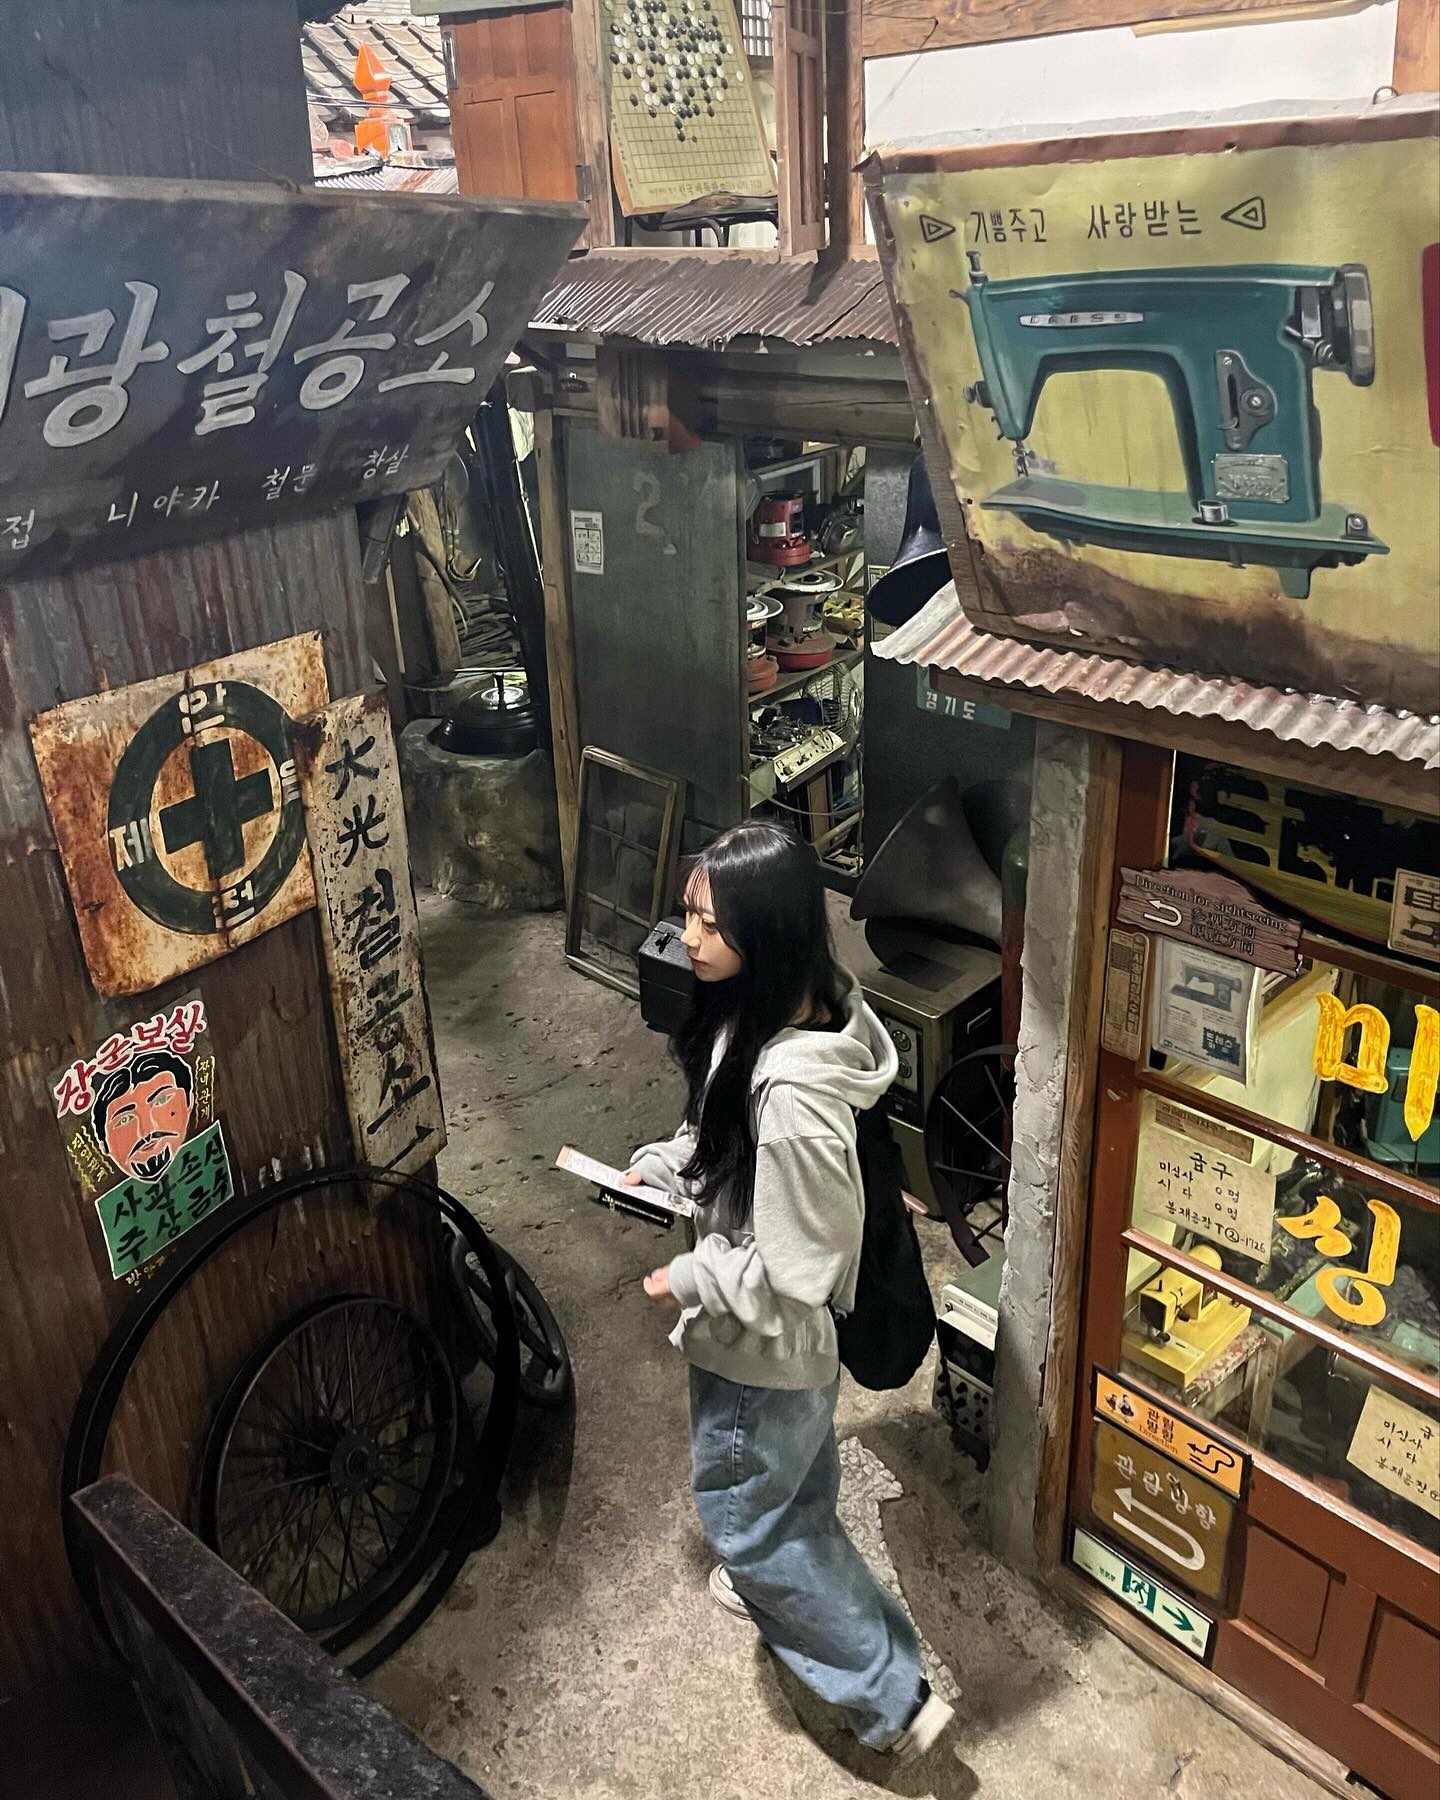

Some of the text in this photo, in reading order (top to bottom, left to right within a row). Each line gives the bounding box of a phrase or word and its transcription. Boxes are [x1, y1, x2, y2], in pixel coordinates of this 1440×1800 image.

[970, 200, 1202, 243] 기쁨주고 사랑받는
[1192, 892, 1210, 908] for
[1214, 902, 1288, 932] sightseeing
[1190, 1152, 1233, 1180] 급구
